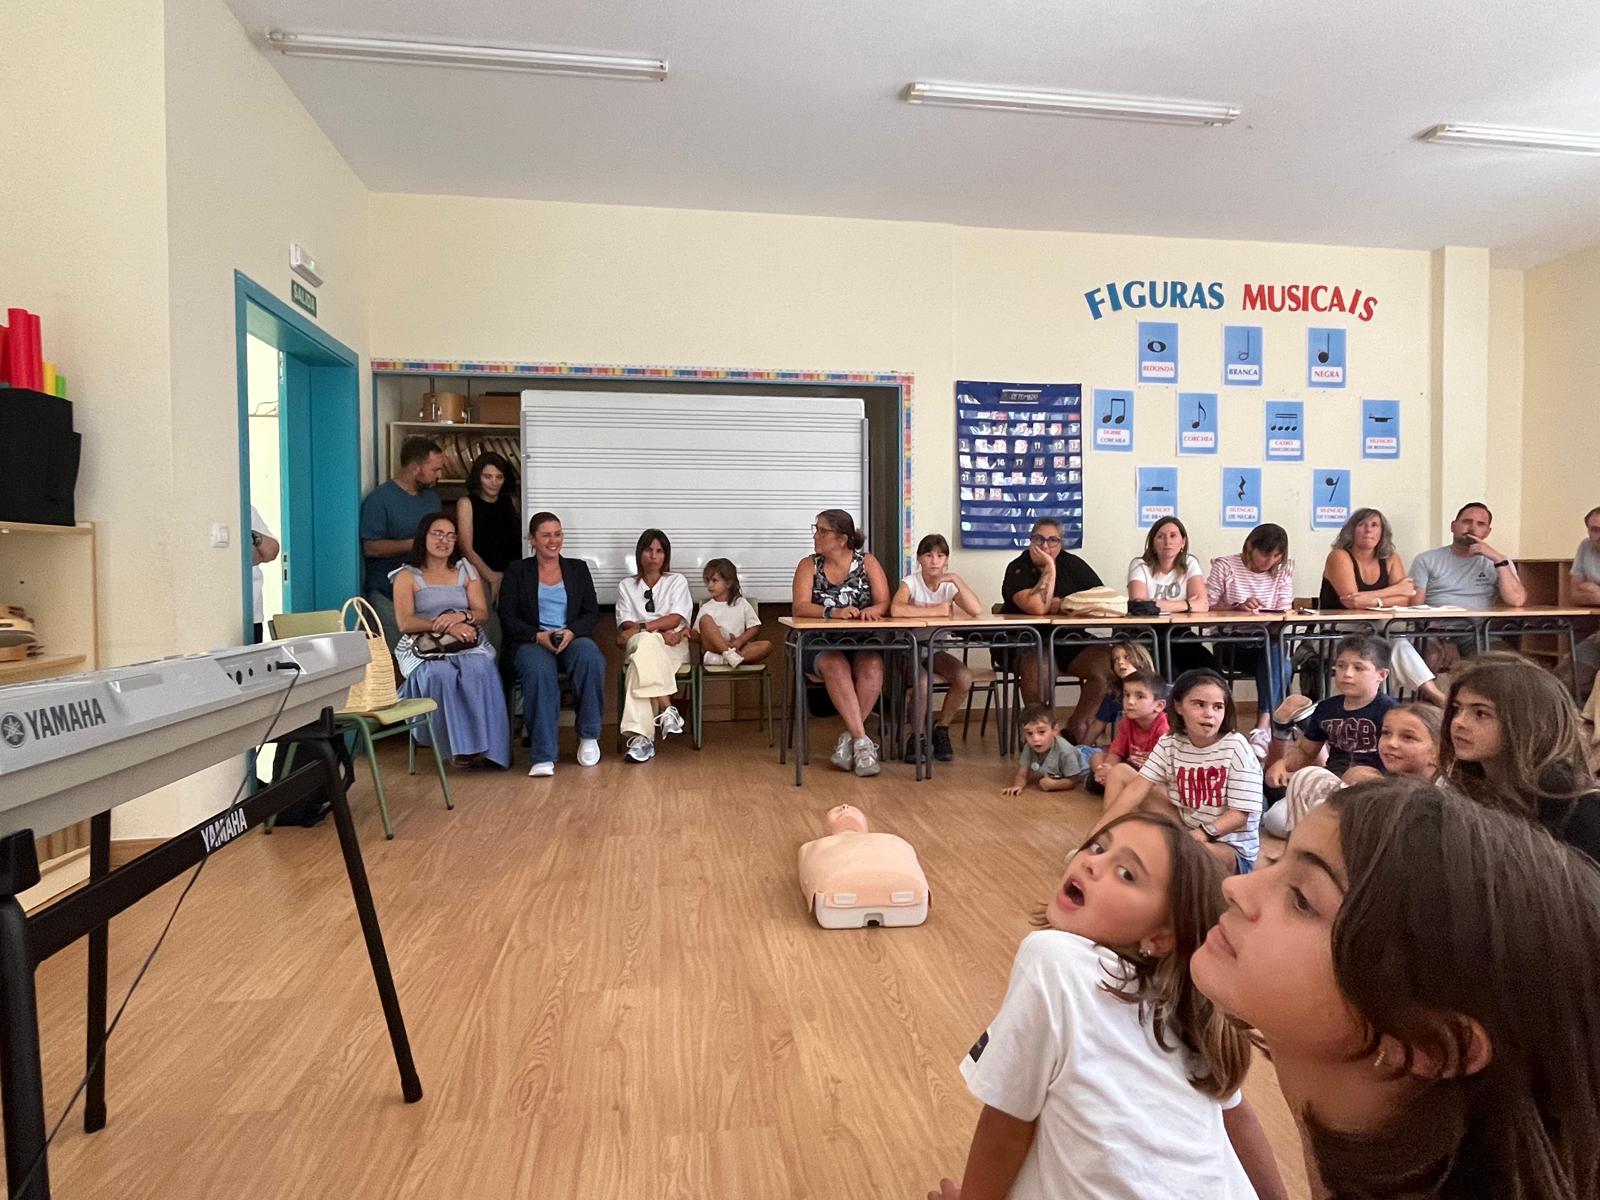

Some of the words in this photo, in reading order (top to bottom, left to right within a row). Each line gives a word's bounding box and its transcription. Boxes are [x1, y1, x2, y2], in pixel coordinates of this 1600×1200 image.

[294, 283, 315, 313] SALIDA
[1084, 280, 1225, 320] FIGURAS
[1242, 283, 1378, 322] MUSICAIS
[1143, 365, 1174, 373] REDONDA
[1229, 368, 1258, 376] BRANCA
[1314, 370, 1340, 378] NEGRA
[24, 698, 107, 740] YAMAHA
[201, 807, 248, 854] YAMAHA
